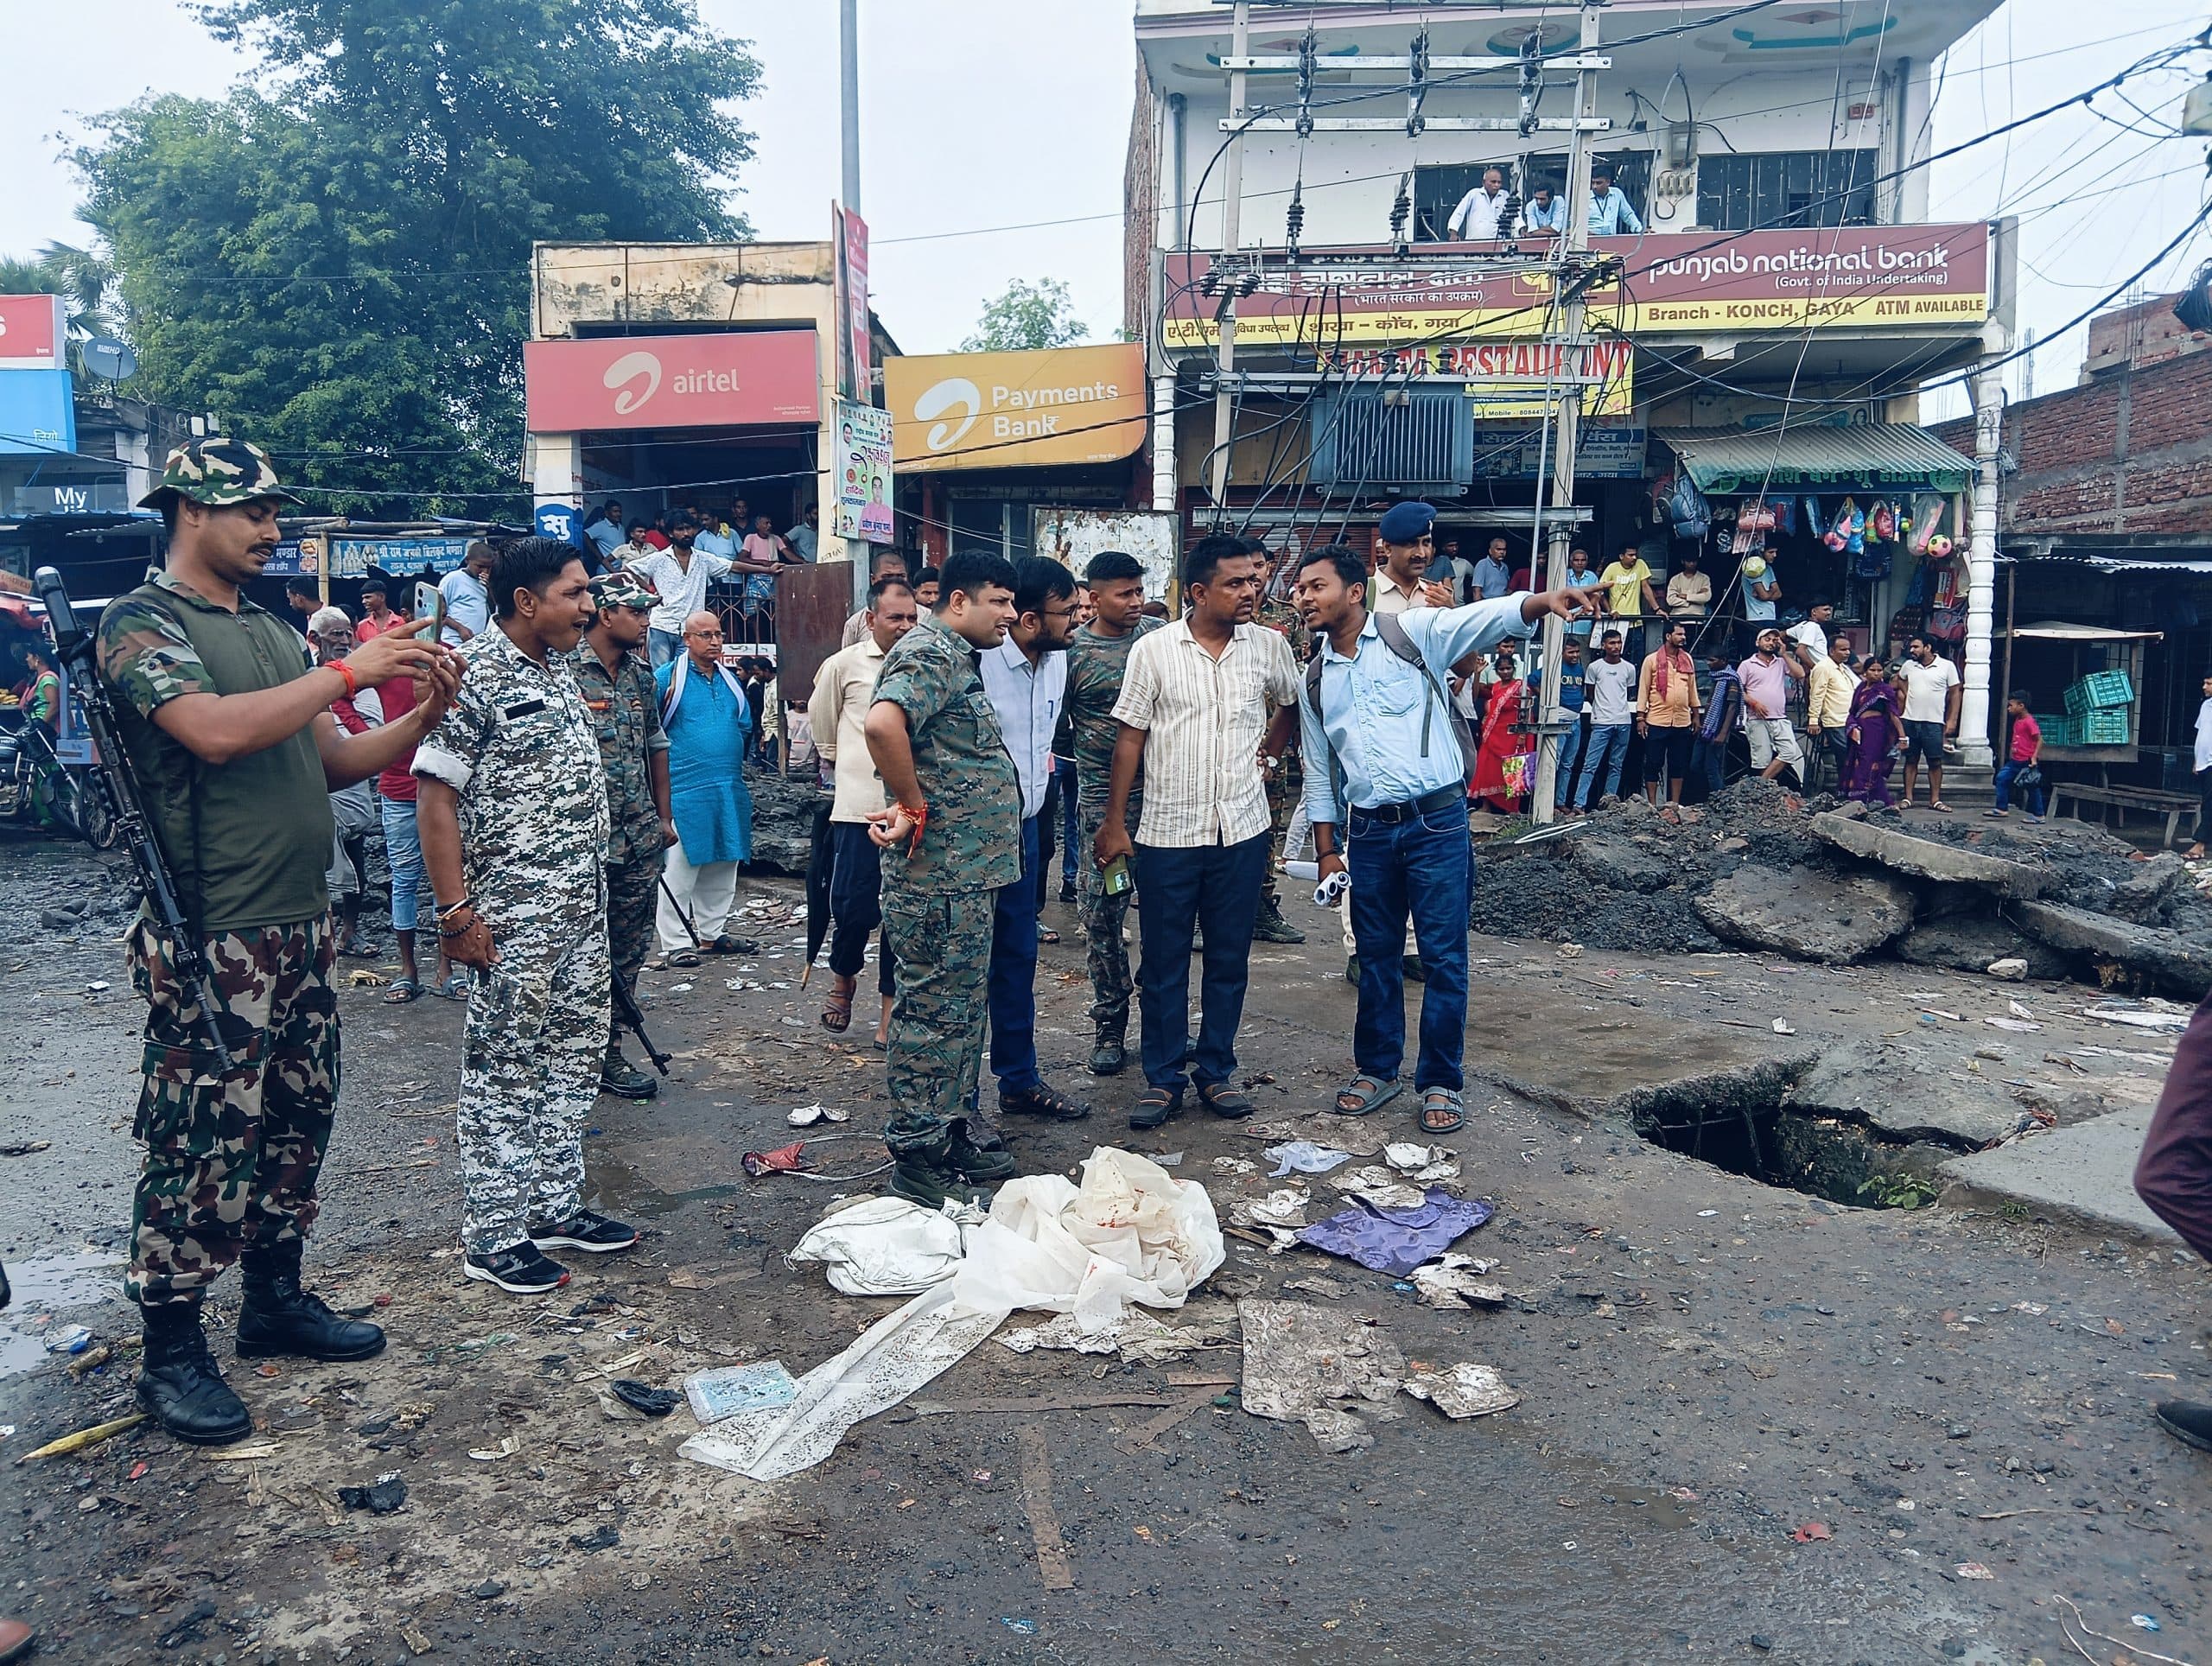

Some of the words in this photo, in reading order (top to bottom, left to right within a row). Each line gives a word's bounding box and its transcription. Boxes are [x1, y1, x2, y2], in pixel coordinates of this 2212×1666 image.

[1649, 248, 1749, 283] punjab
[1753, 245, 1872, 273] national
[1878, 242, 1948, 270] bank
[1775, 275, 1813, 289] (Govt.
[1816, 274, 1830, 286] of
[1833, 273, 1863, 286] India
[1866, 271, 1948, 286] Undertaking)
[1389, 292, 1425, 304] सरकार
[1428, 292, 1443, 303] का
[1649, 306, 1709, 321] Branch
[1727, 303, 1799, 320] KONCH,
[1805, 302, 1855, 317] GAYA
[1875, 300, 1910, 315] ATM
[1915, 299, 1984, 314] AVAILABLE
[1233, 321, 1256, 337] ुविधा
[1425, 317, 1459, 329] गया
[673, 368, 741, 394] airtel
[992, 381, 1119, 411] Payments
[994, 414, 1060, 437] Bank
[54, 486, 87, 508] My
[540, 514, 571, 541] सु
